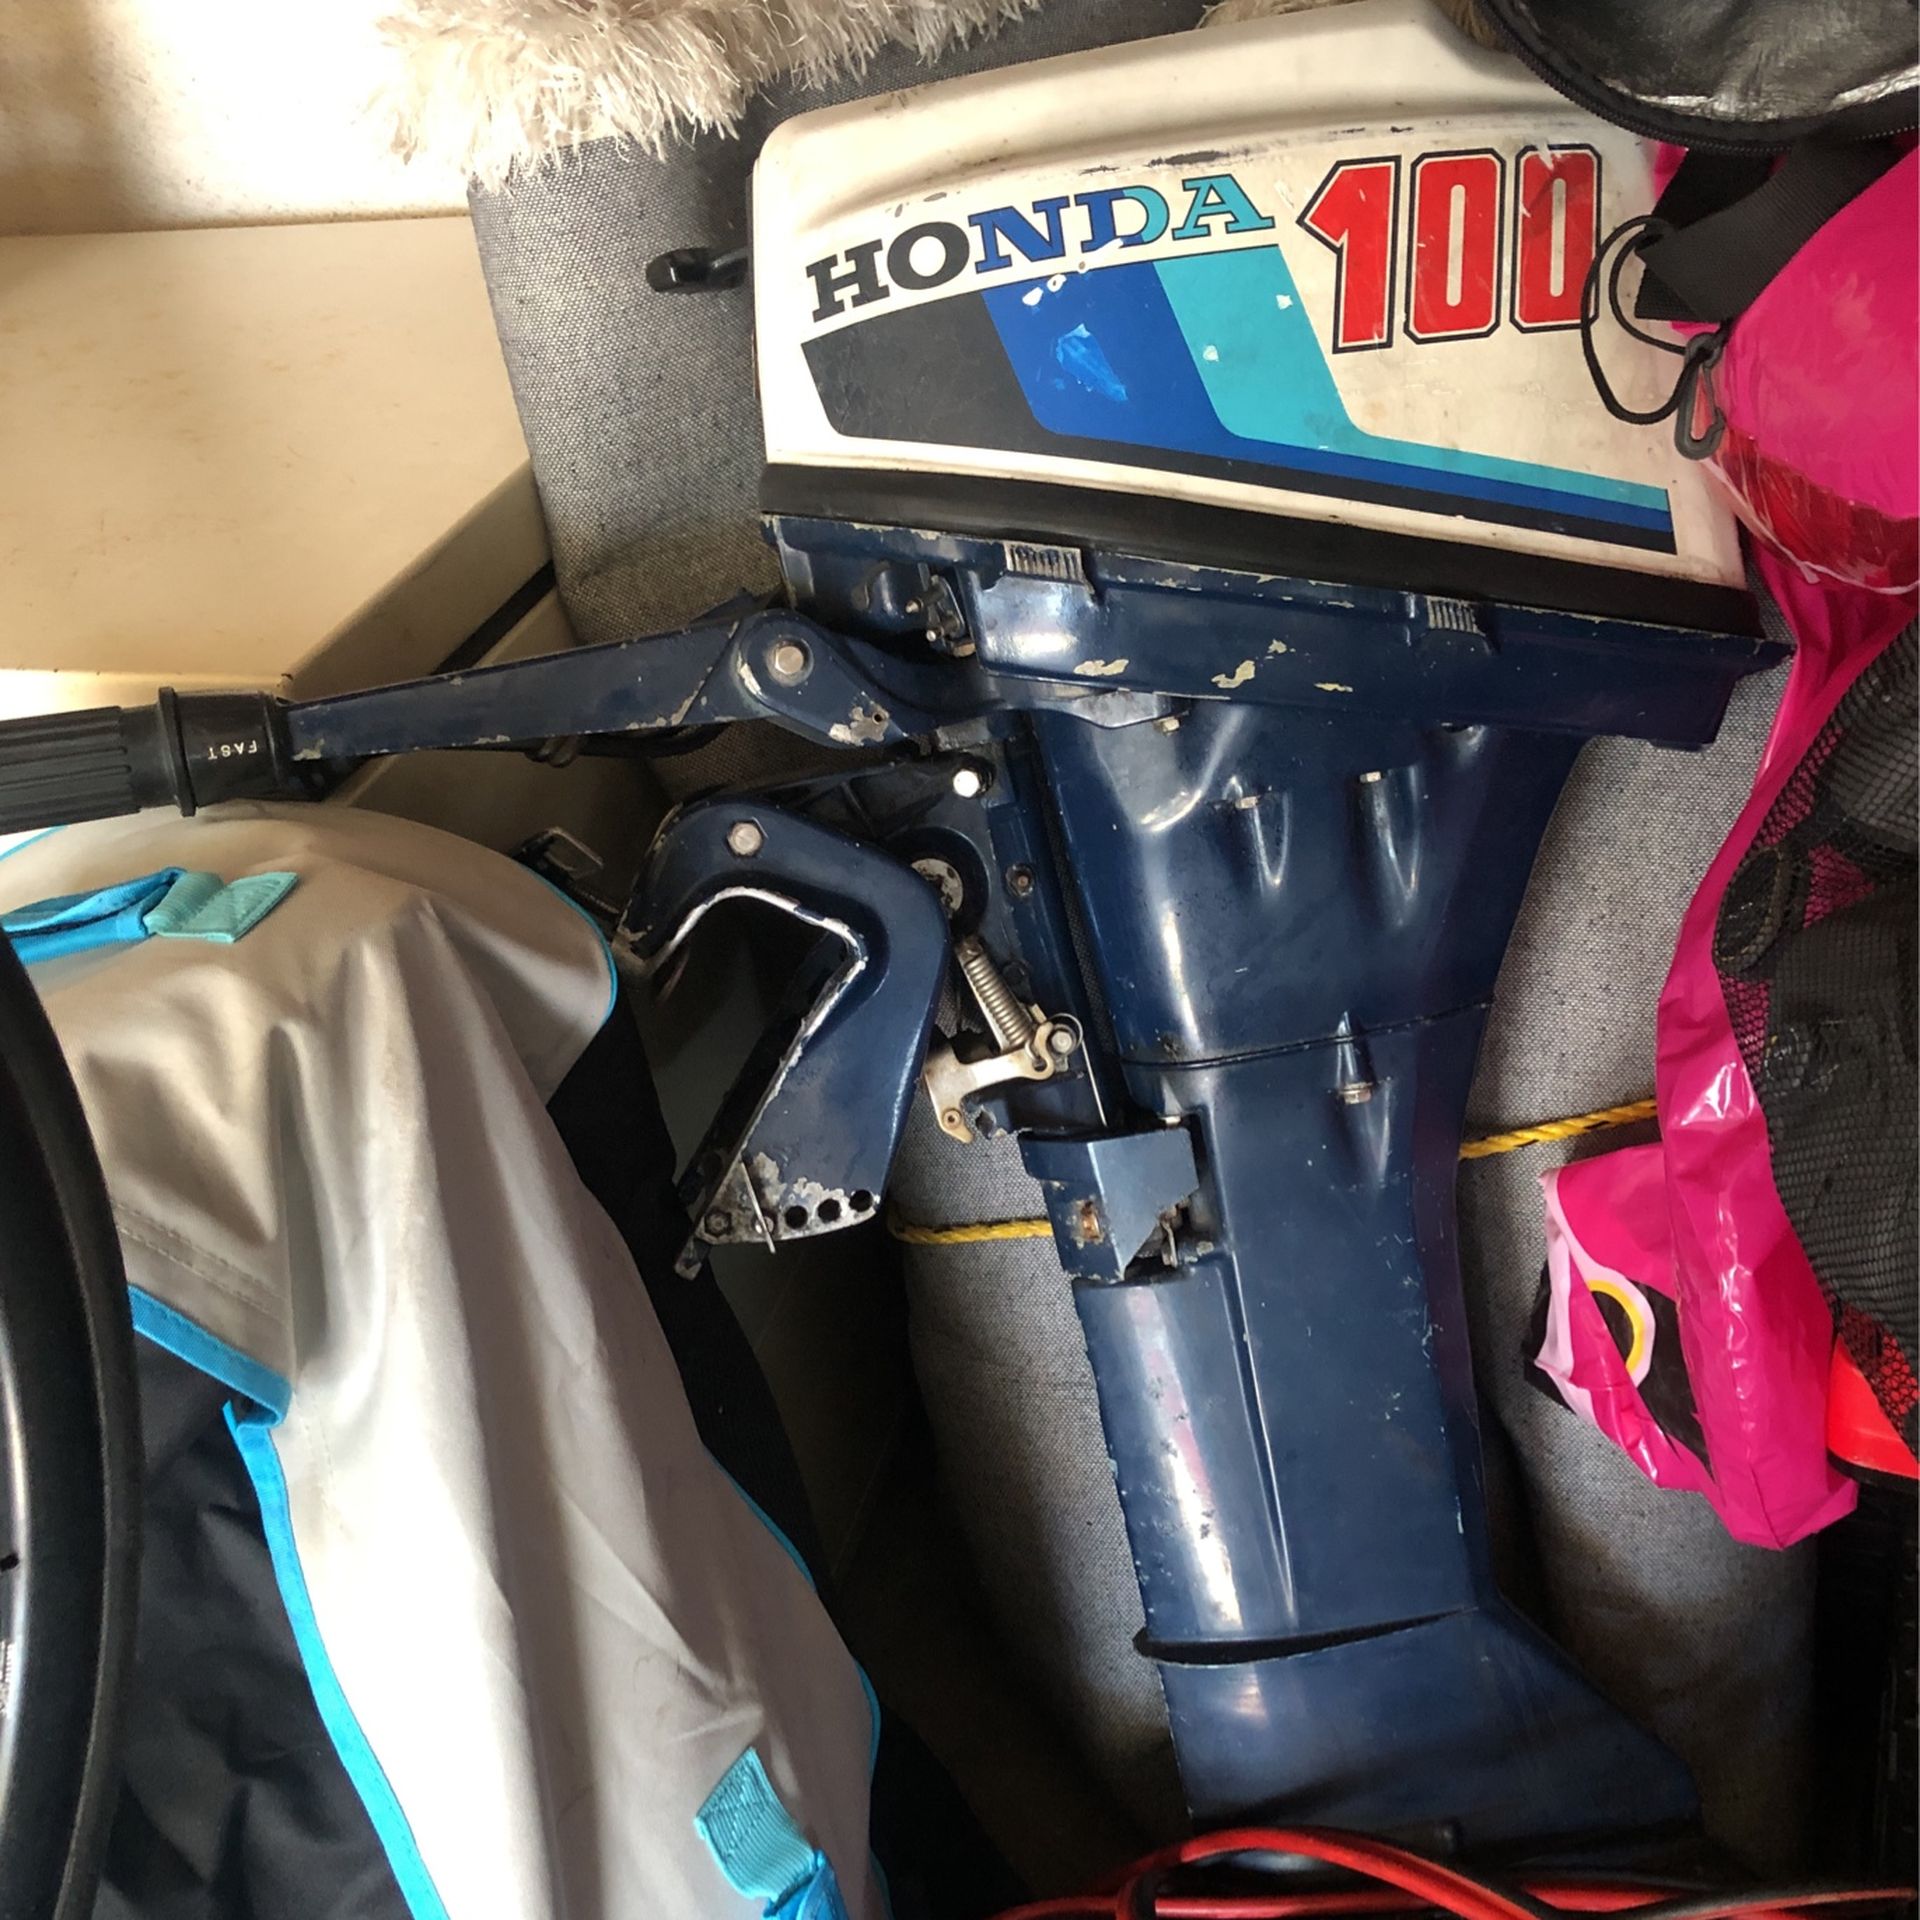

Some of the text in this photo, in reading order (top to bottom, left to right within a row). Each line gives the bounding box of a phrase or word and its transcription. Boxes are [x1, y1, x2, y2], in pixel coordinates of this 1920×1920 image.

[806, 143, 1602, 355] HONDA 100
[207, 739, 258, 760] FAST
